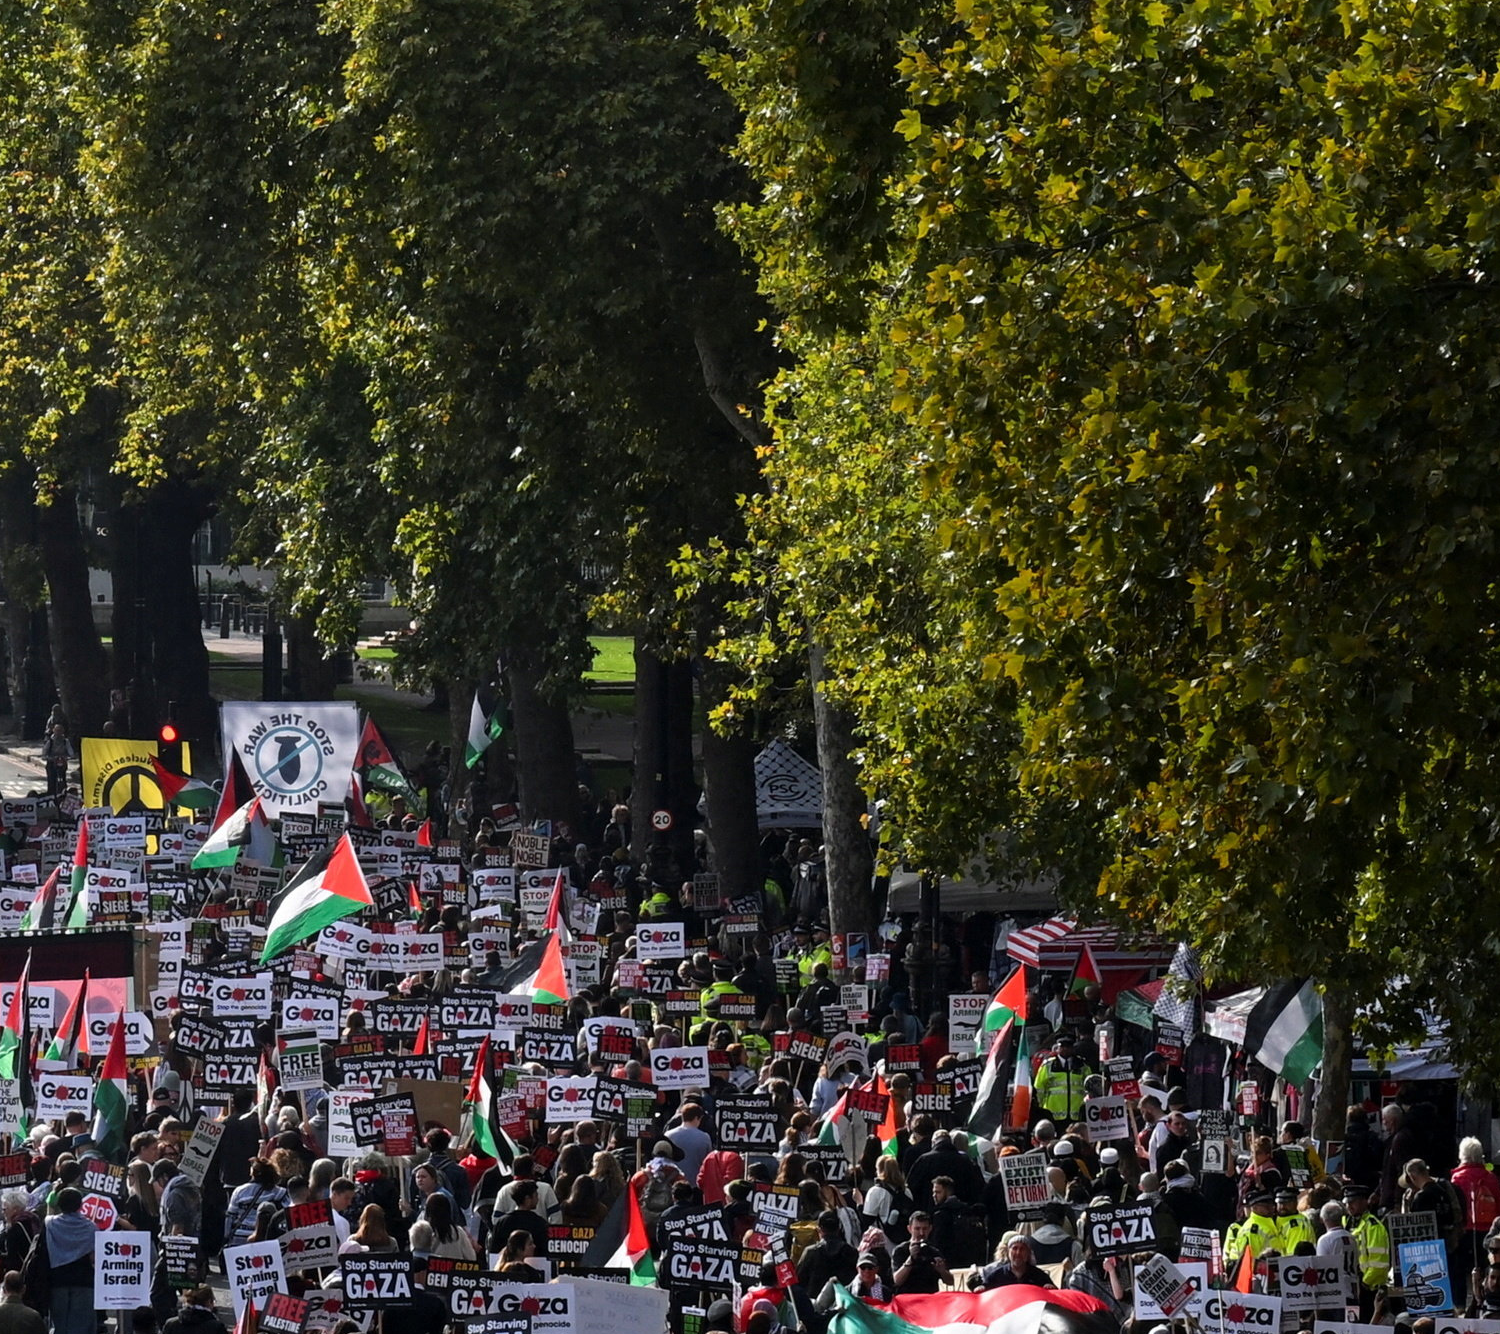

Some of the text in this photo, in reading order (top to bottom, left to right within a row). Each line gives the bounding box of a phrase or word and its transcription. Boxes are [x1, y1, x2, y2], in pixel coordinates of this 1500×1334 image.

[769, 782, 801, 794] PSC
[655, 815, 668, 824] 20
[517, 835, 548, 850] NOBLE
[1005, 1167, 1042, 1179] EXIST!
[1006, 1177, 1047, 1190] RESIST!
[1008, 1186, 1049, 1203] RETURN!
